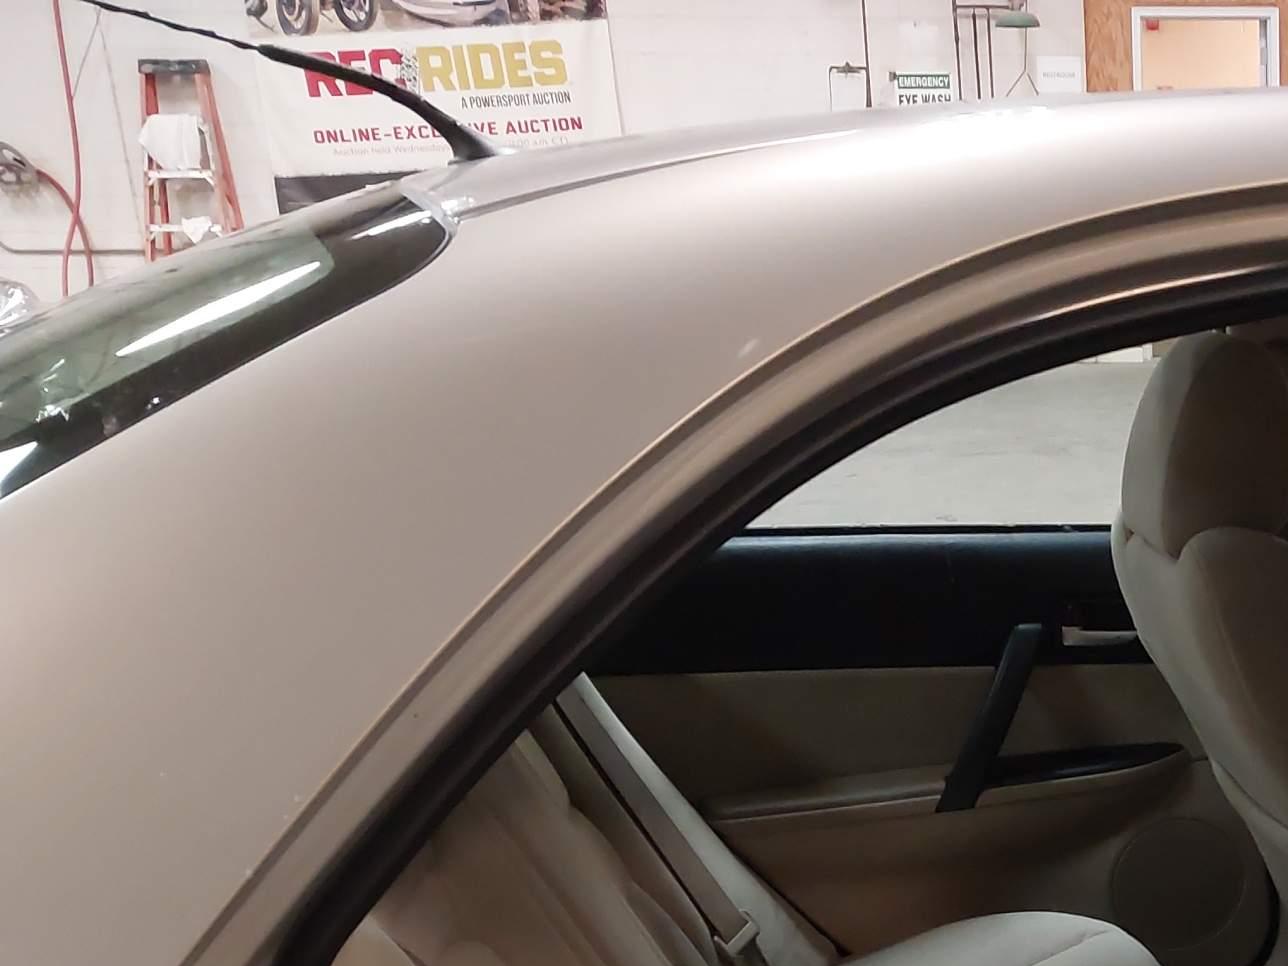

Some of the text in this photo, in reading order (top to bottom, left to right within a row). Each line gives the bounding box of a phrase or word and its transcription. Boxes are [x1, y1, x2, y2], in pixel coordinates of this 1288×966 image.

[304, 40, 568, 97] REC RIDES
[899, 76, 950, 87] EMERGENCY
[461, 90, 571, 109] A POWERSPORT AUCTION
[506, 117, 583, 135] AUCTION
